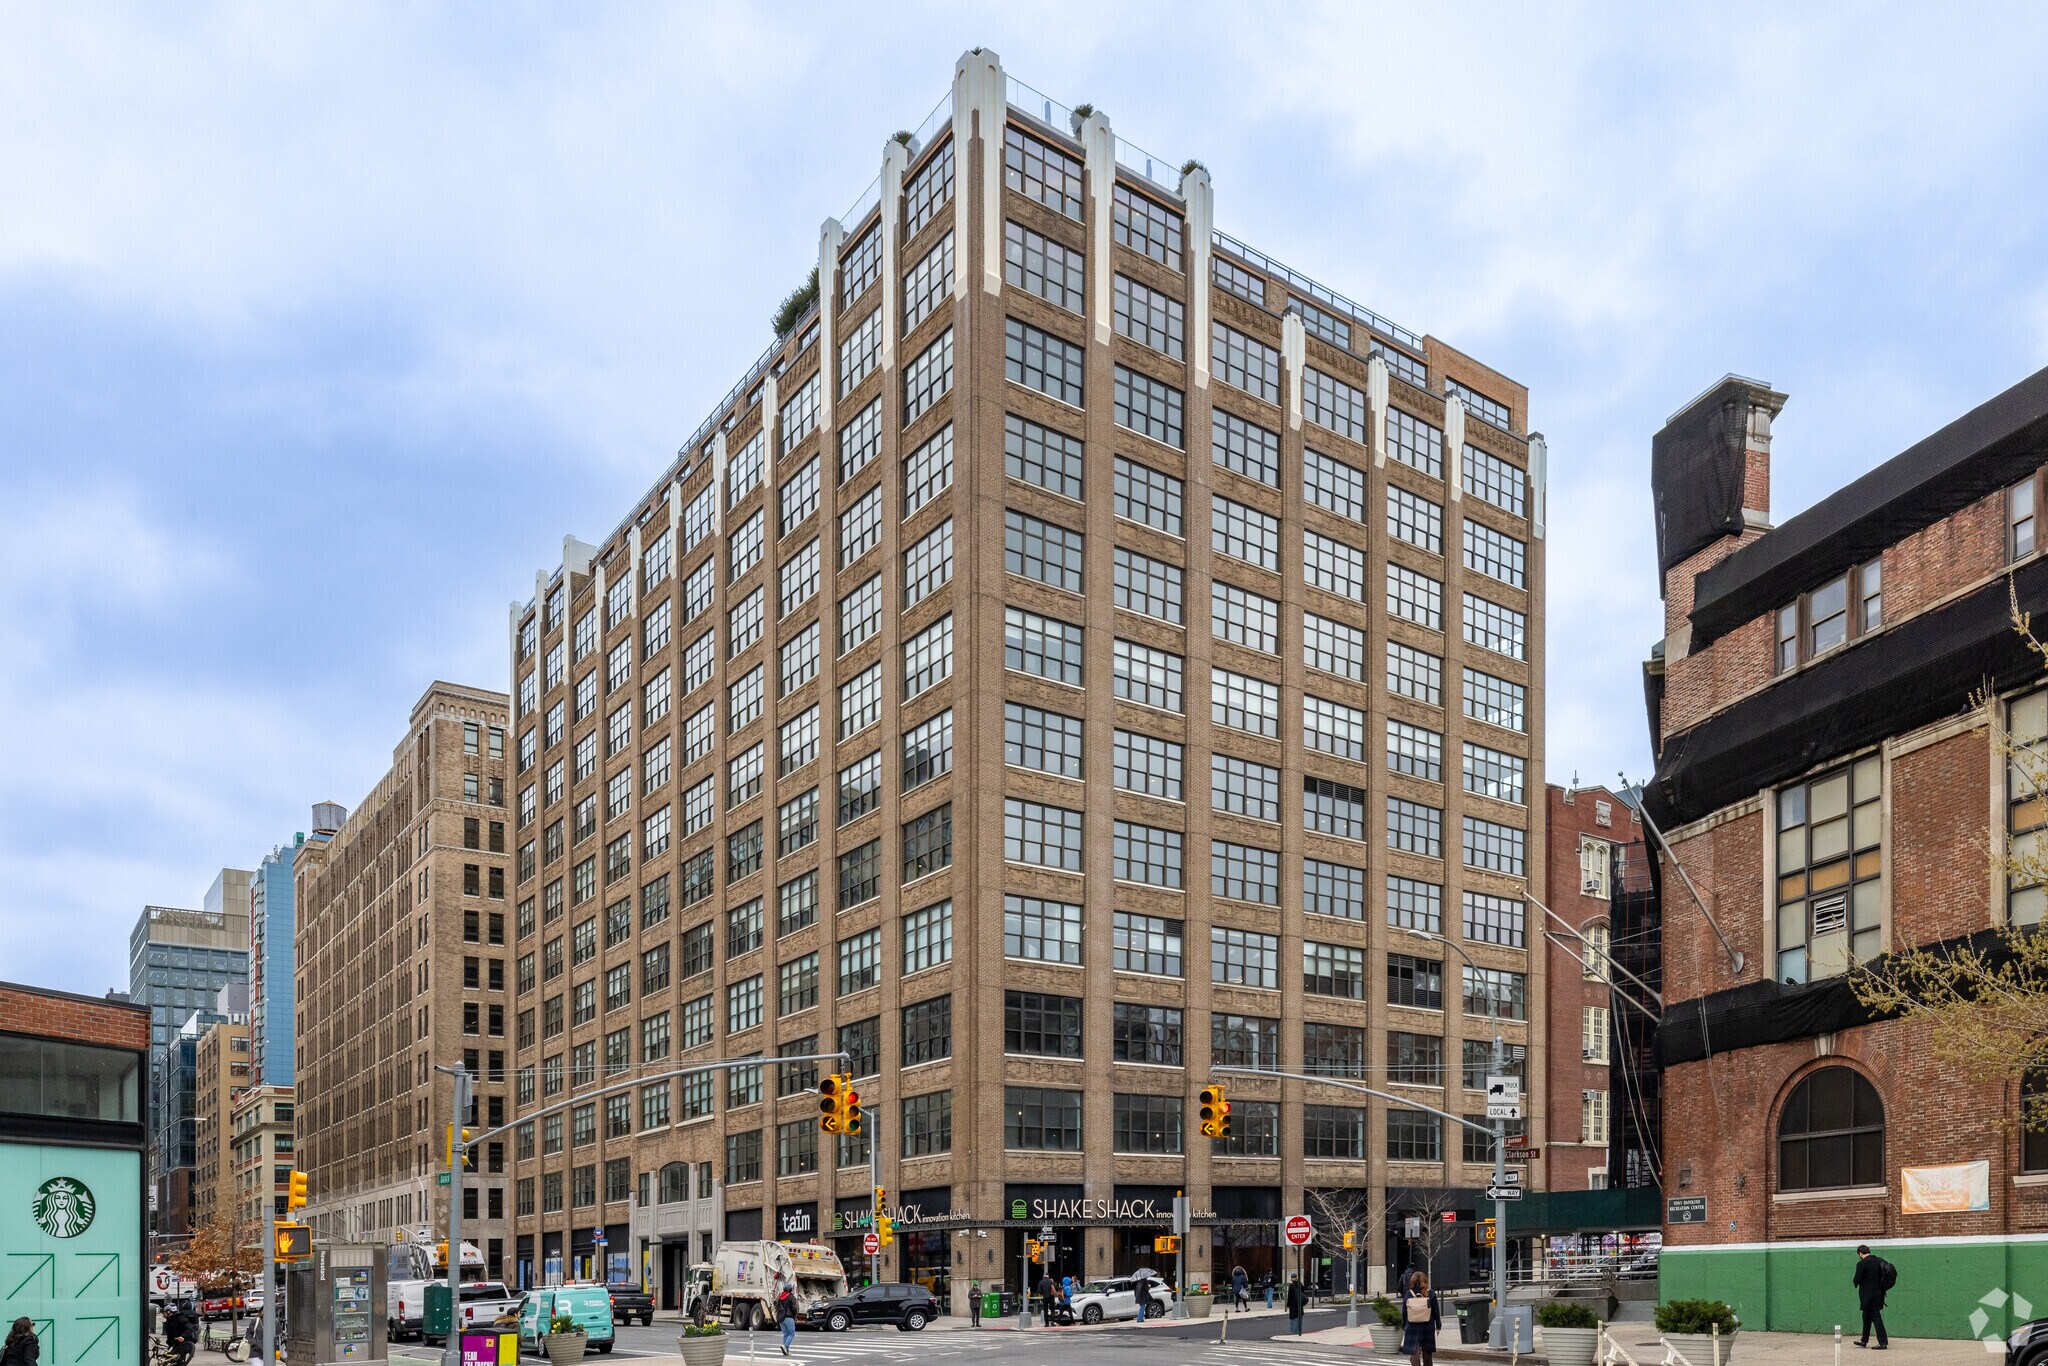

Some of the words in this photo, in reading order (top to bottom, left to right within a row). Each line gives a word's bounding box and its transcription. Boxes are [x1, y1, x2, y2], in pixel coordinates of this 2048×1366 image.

[1489, 1107, 1507, 1115] LOCAL
[1506, 1150, 1529, 1159] Clarkson
[1530, 1150, 1536, 1158] St
[1033, 1199, 1093, 1219] SHAKE
[1097, 1199, 1156, 1219] SHACK
[1193, 1207, 1217, 1219] kitchen
[783, 1209, 811, 1233] taïm
[844, 1208, 879, 1229] SHAK
[882, 1204, 922, 1225] SHACK
[922, 1212, 949, 1224] innovation
[949, 1208, 972, 1221] kitchen
[1486, 1226, 1496, 1239] 22
[464, 1351, 478, 1361] YEAH
